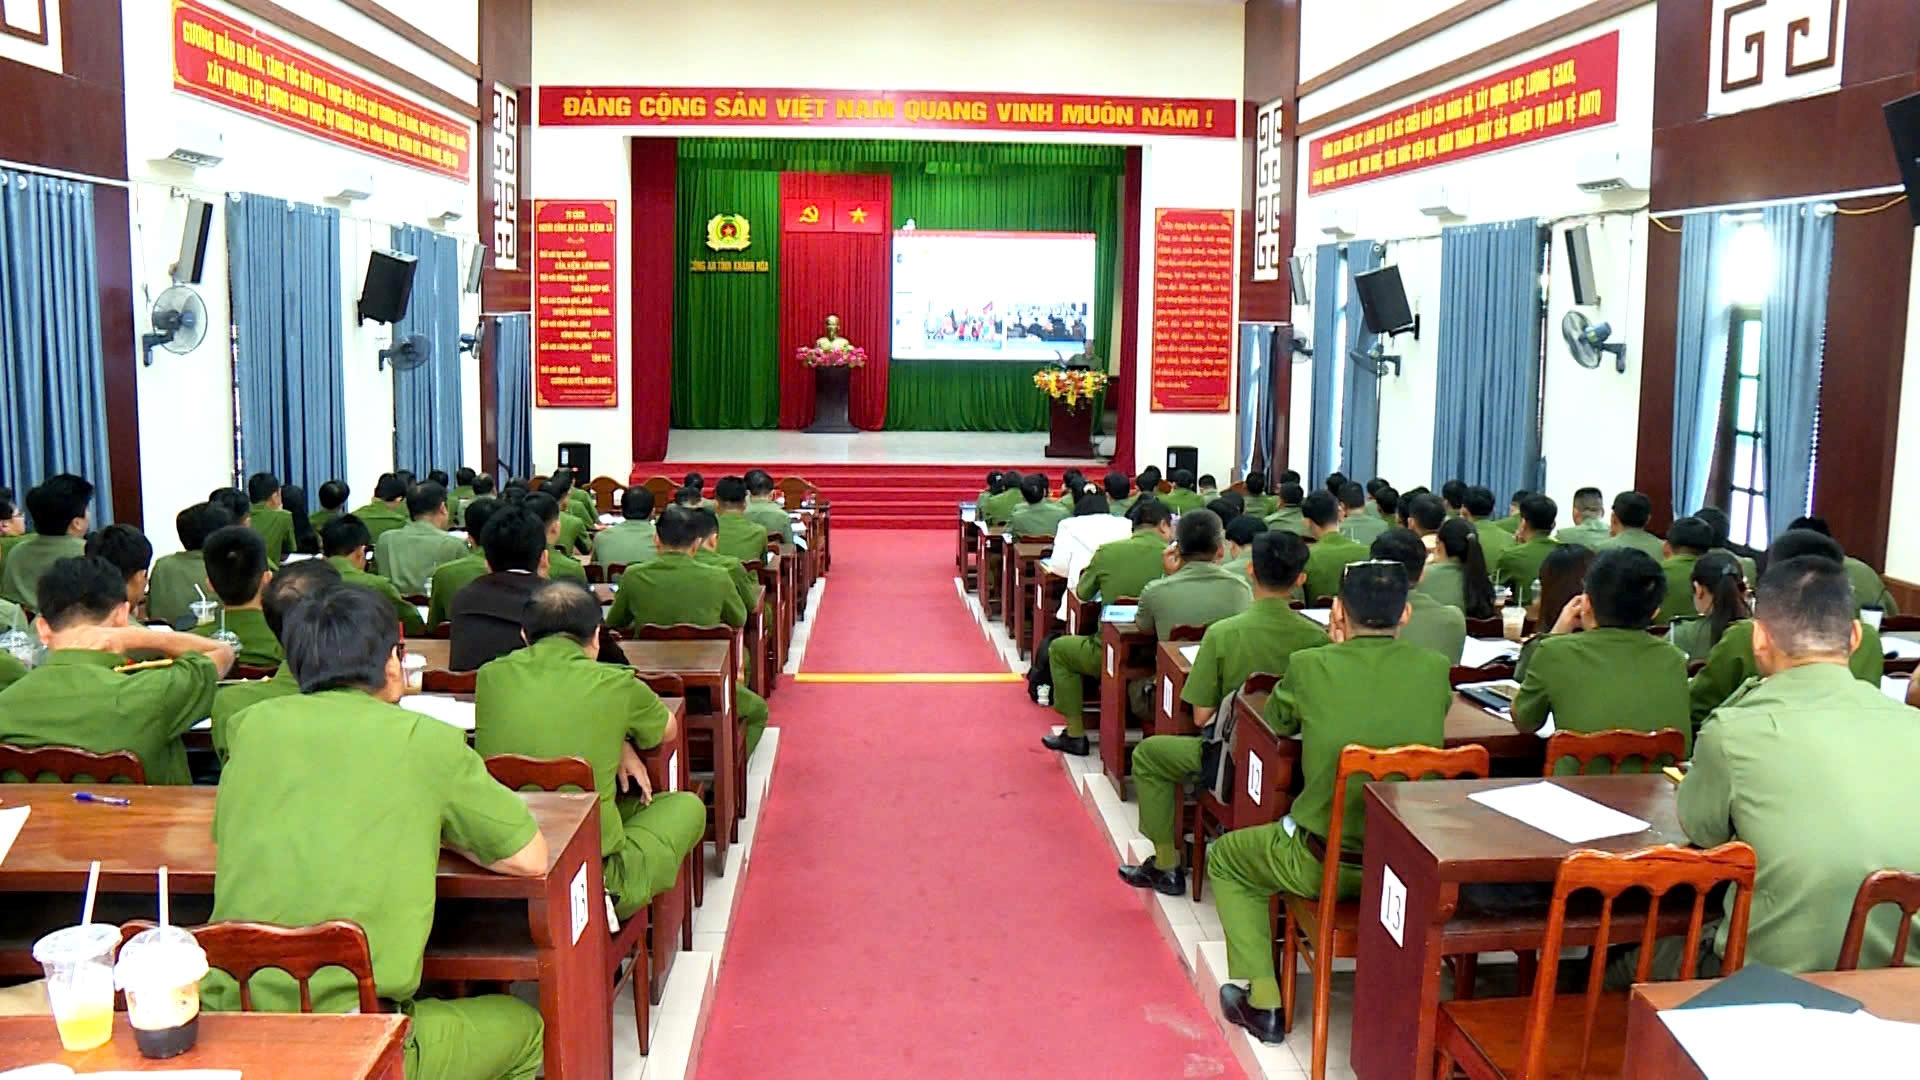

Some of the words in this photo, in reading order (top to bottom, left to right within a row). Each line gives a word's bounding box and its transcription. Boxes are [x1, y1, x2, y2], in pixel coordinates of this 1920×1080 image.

[207, 59, 224, 86] XÂY
[225, 68, 248, 96] DỰNG
[249, 77, 264, 104] LỰC
[563, 89, 632, 117] ĐẢNG
[640, 91, 706, 121] CỘNG
[714, 91, 767, 118] SẢN
[776, 94, 827, 123] VIỆT
[836, 97, 895, 119] NAM
[903, 101, 987, 124] QUANG
[996, 103, 1053, 123] VINH
[1061, 101, 1134, 125] MUÔN
[1142, 103, 1199, 127] NĂM
[1204, 108, 1214, 128] !
[1565, 90, 1577, 124] VỆ
[1578, 88, 1601, 117] ANTQ
[1386, 885, 1401, 930] 13
